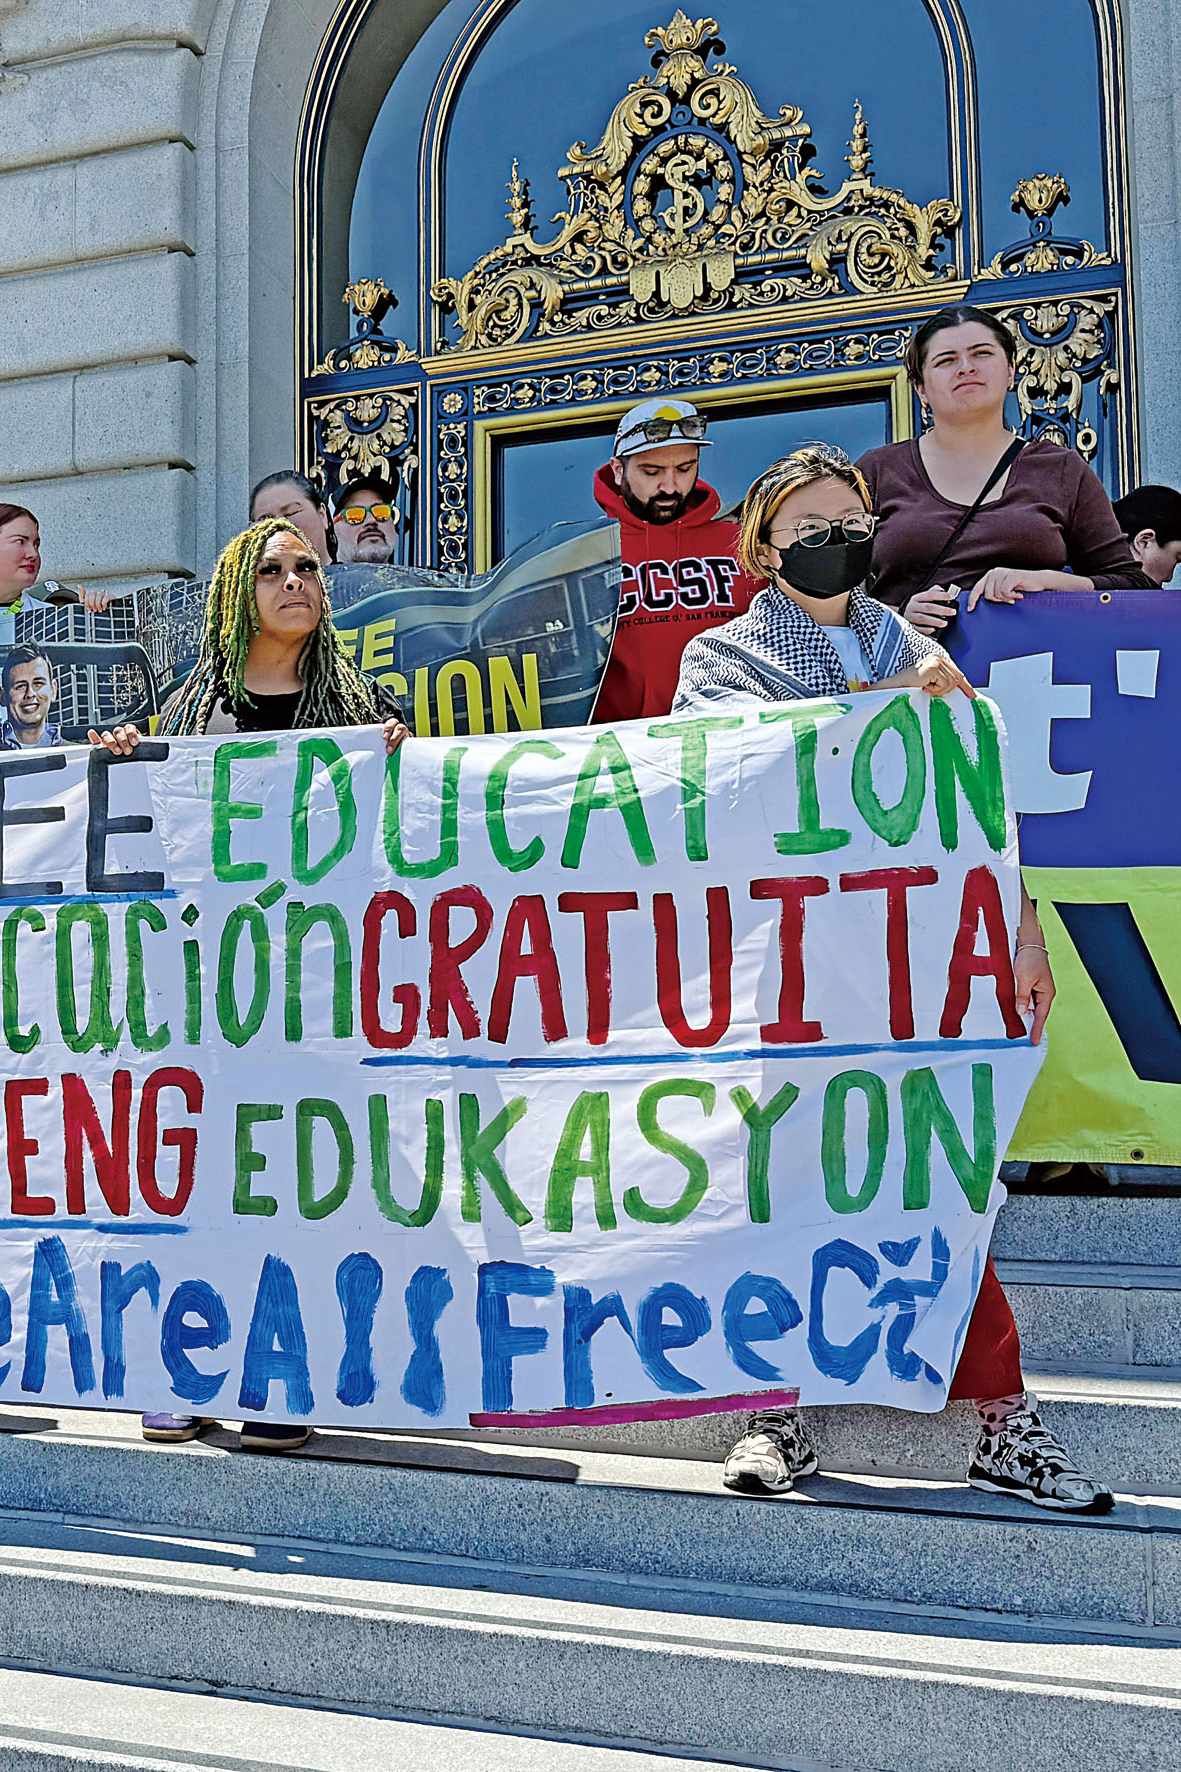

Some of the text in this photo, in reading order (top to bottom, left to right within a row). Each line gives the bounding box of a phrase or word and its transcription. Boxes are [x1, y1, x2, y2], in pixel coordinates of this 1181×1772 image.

[633, 615, 671, 625] COLLEGE
[685, 611, 702, 621] SAN
[212, 694, 1007, 885] EDUCATION
[360, 865, 1028, 1049] GRATUITA
[233, 1062, 998, 1232] EDUKASYON
